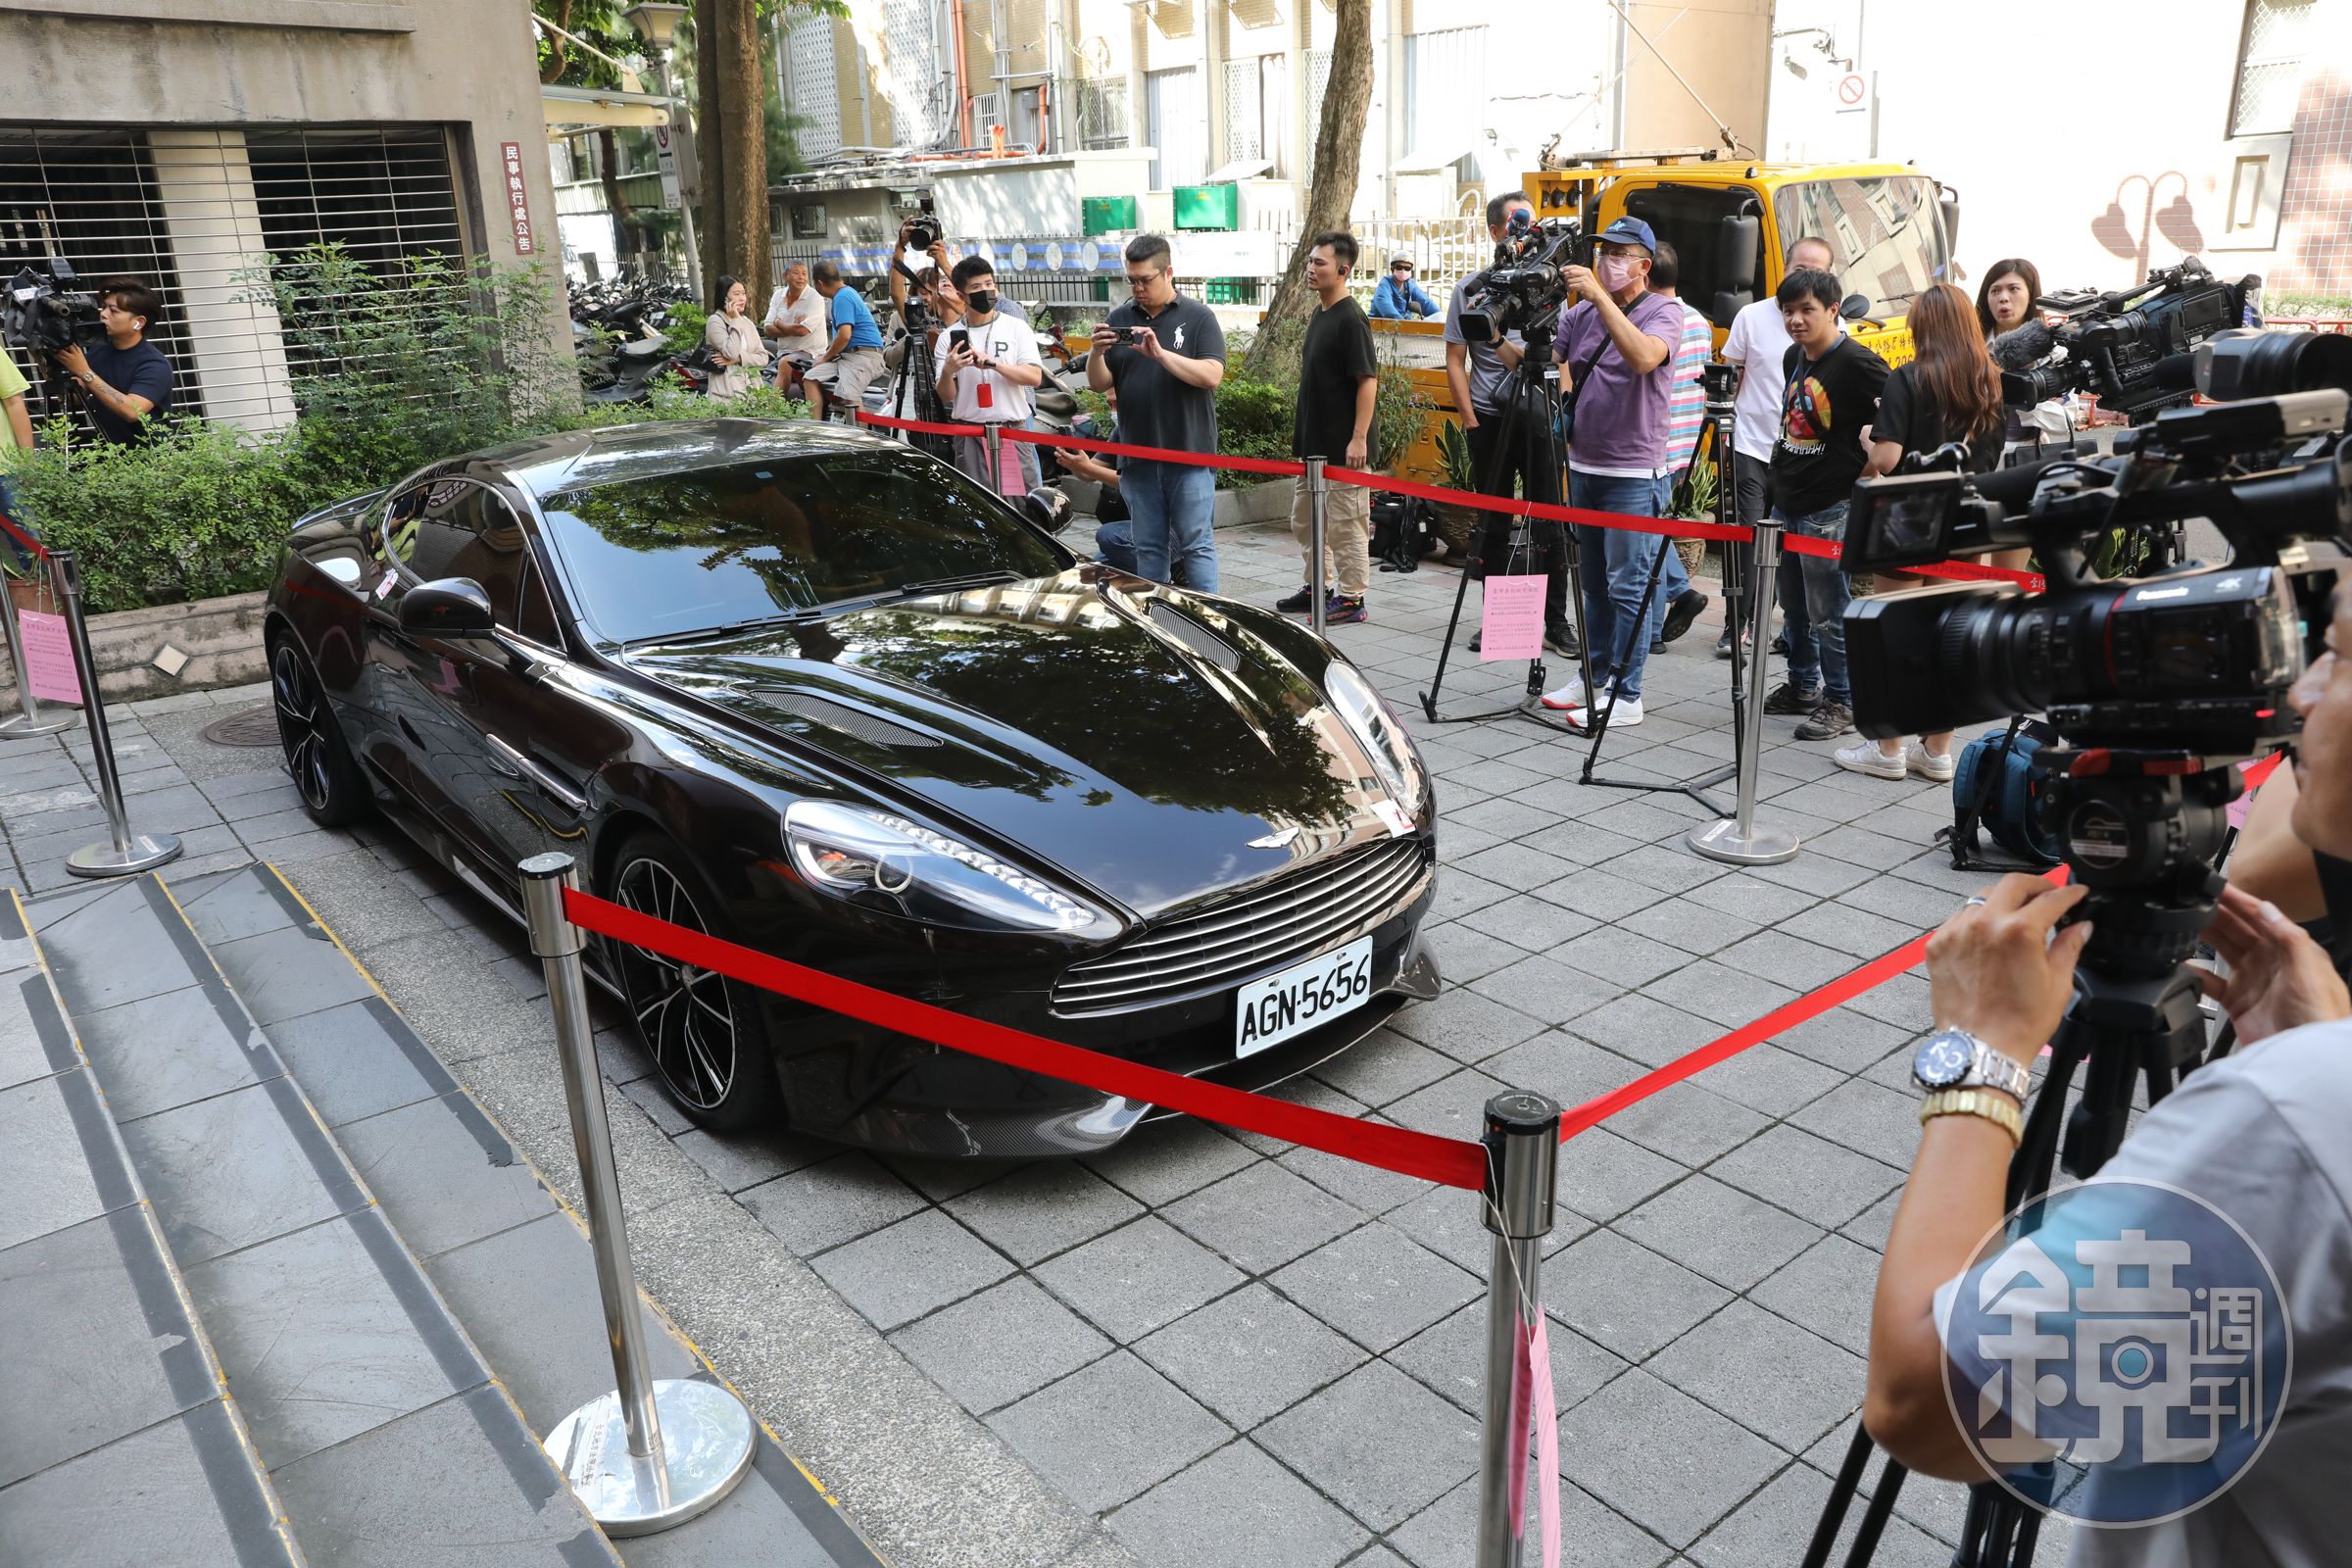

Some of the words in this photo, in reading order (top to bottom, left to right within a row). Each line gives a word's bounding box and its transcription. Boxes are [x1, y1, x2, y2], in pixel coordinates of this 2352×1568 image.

[506, 146, 530, 251] 民事執行處公告
[995, 341, 1008, 357] P
[1241, 954, 1369, 1046] AGN-5656
